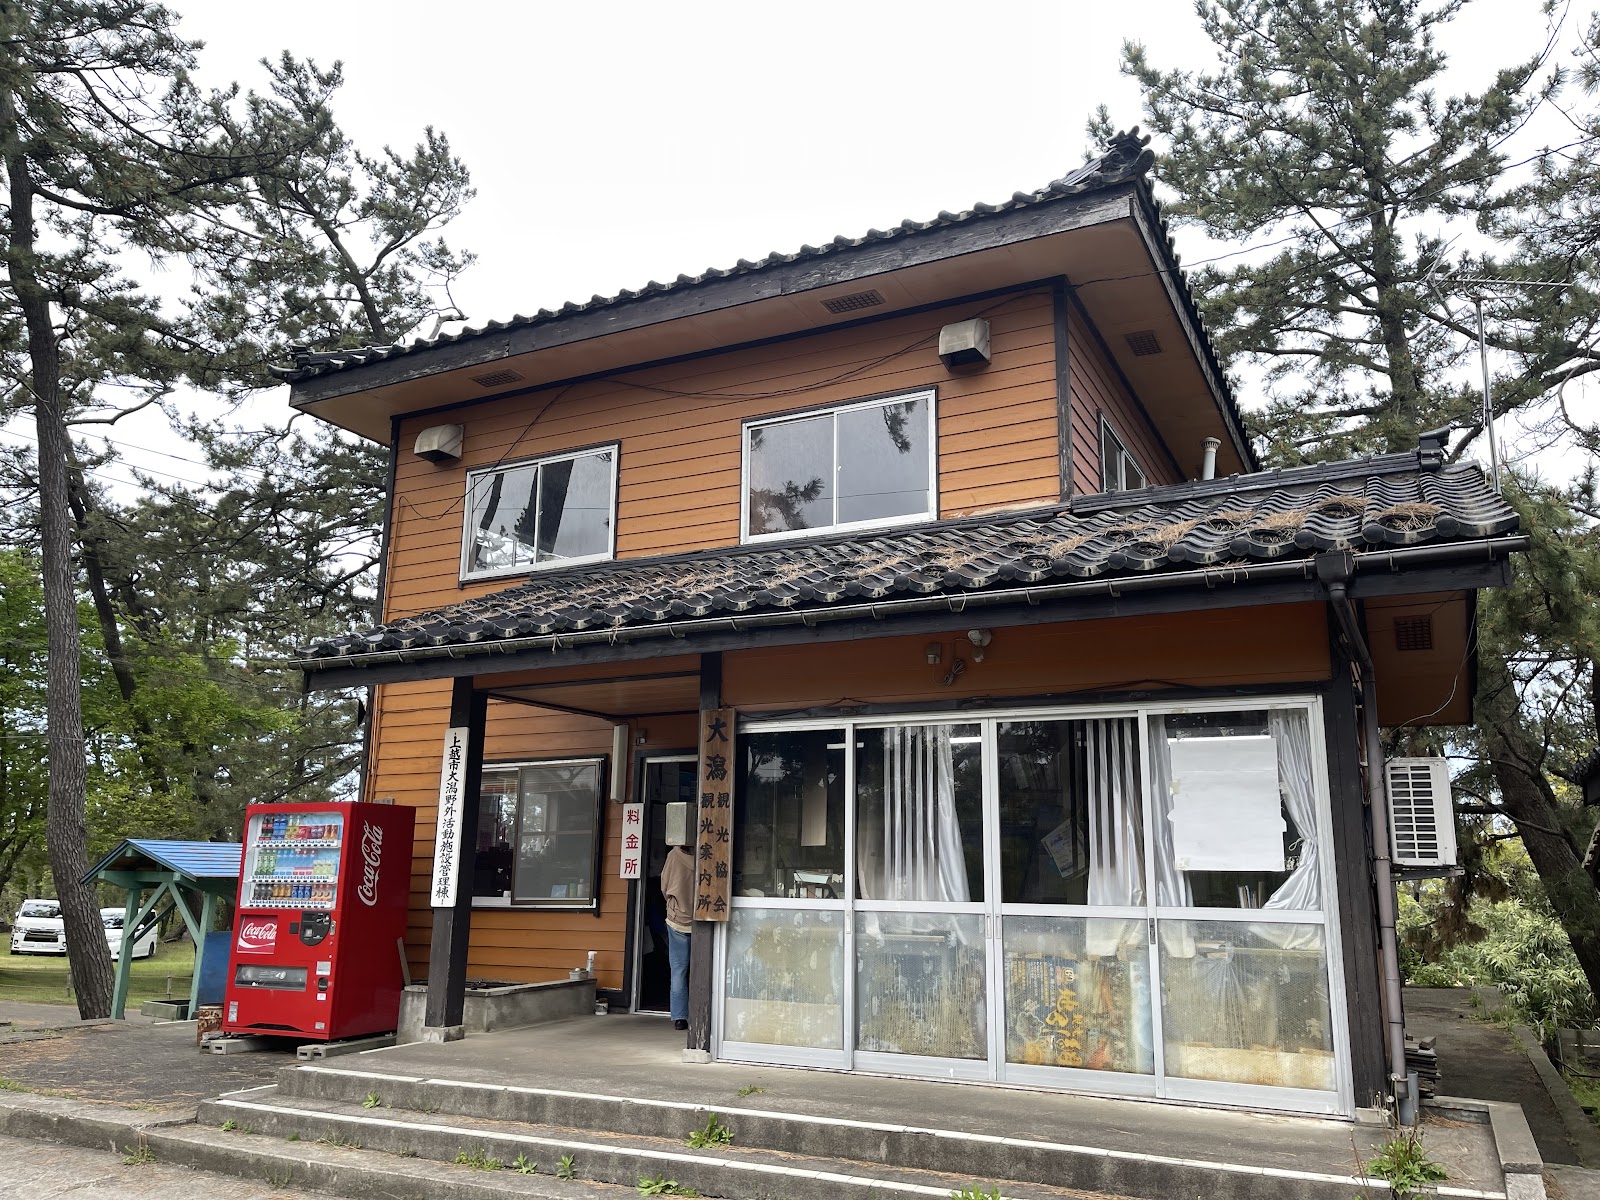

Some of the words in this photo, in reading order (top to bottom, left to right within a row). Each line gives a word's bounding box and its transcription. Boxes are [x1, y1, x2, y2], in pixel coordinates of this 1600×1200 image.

[705, 717, 729, 781] 大潟
[357, 819, 384, 907] Coca-Cola
[435, 734, 461, 899] 上越市大潟野外活動施設管理棟
[624, 809, 640, 875] 料金所
[696, 792, 715, 913] 観光案内所
[712, 791, 730, 913] 観光協会
